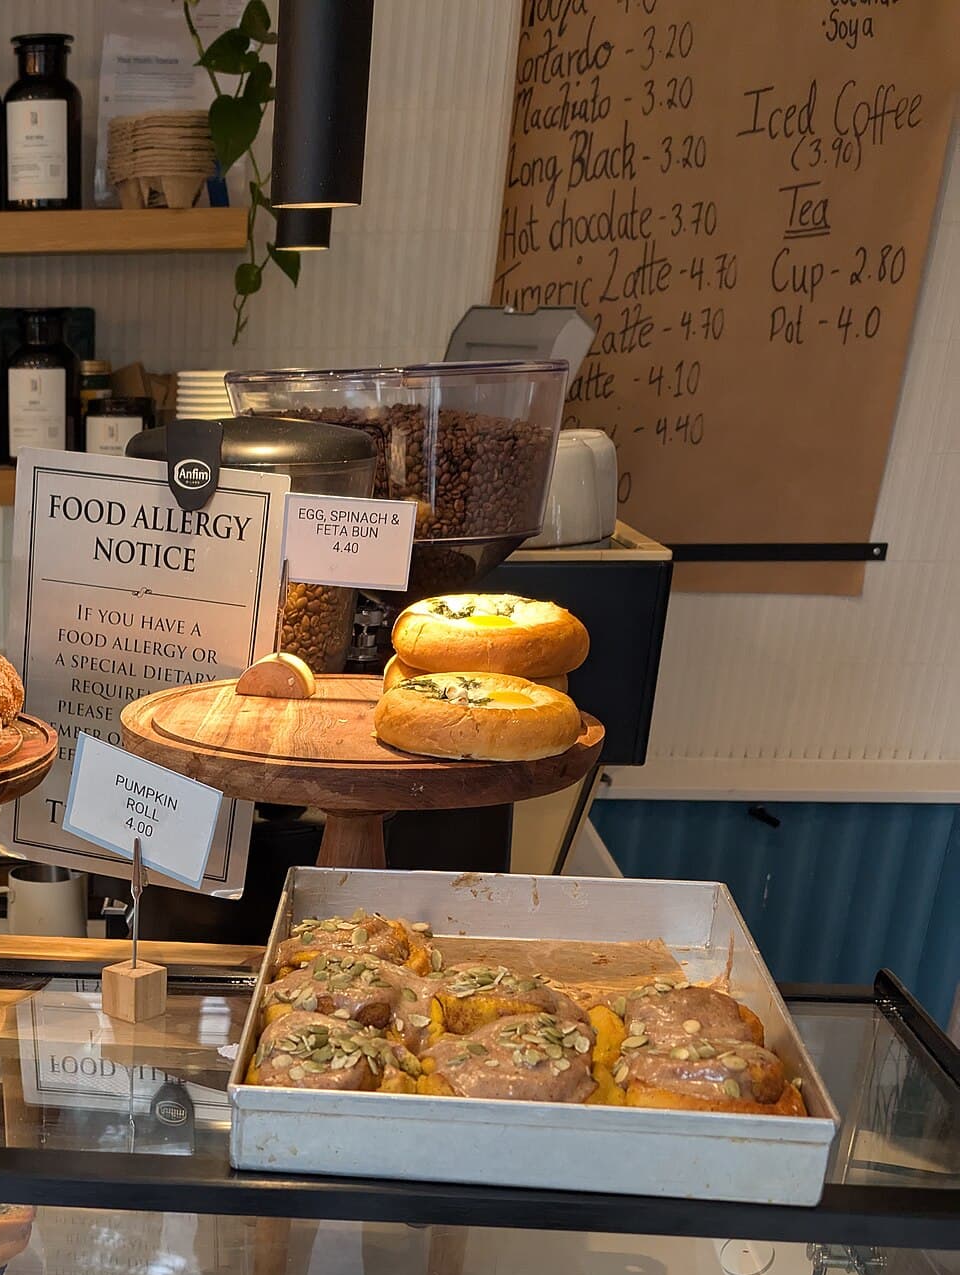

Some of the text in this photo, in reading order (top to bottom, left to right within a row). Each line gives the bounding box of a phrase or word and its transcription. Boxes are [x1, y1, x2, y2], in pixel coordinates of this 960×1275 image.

[641, 22, 694, 71] 3.20
[512, 76, 611, 137] Macchiato
[641, 76, 694, 116] 3.20
[735, 79, 922, 145] Iced Coffee
[508, 142, 563, 207] Long
[567, 120, 637, 192] Black
[660, 135, 707, 174] 3.20
[778, 181, 831, 229] Tea
[502, 203, 540, 262] Hot
[548, 187, 653, 252] chocolate
[670, 201, 718, 237] 3.70
[495, 255, 593, 312] Tumeric
[599, 240, 673, 304] Latte
[689, 254, 737, 291] 4.70
[771, 247, 824, 303] Cup
[849, 244, 906, 286] 2.80
[586, 303, 655, 358] Latte
[680, 307, 725, 341] 4.70
[769, 304, 804, 345] Pot
[837, 304, 881, 345] 4.0
[564, 361, 615, 404] atte
[648, 360, 701, 398] 4.10
[655, 412, 705, 446] 4.40
[178, 467, 209, 481] Anfim
[48, 494, 253, 542] FOOD ALLERGY
[298, 507, 400, 526] EGG, SPINACH &
[316, 523, 379, 539] FETA BUN
[92, 536, 197, 573] NOTICE
[332, 541, 360, 554] 4.40
[98, 609, 135, 628] YOU
[141, 615, 186, 635] HAVE
[190, 623, 202, 638] A
[57, 628, 218, 665] FOOD ALLERGY OR
[54, 652, 217, 684] A SPECIAL DIETARY
[58, 699, 113, 721] PLEASE
[115, 773, 179, 811] PUMPKIN
[125, 797, 161, 823] ROLL
[125, 817, 154, 838] 4.00
